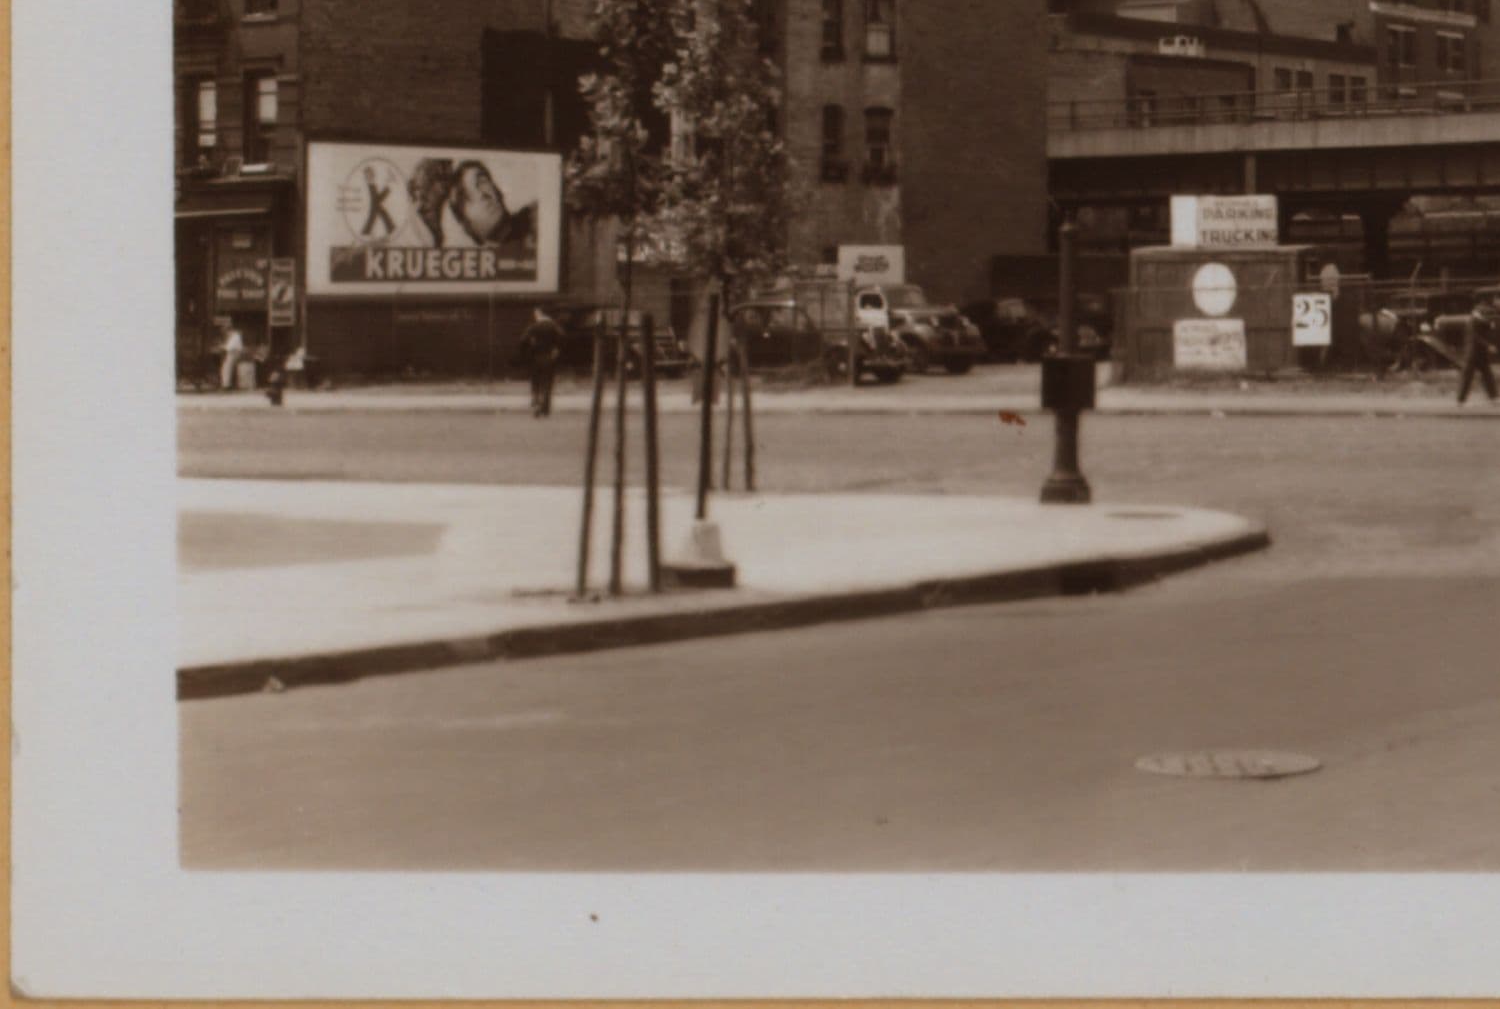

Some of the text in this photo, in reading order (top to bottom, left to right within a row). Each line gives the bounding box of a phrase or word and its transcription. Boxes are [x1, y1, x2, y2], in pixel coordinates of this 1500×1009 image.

[1202, 207, 1274, 221] PARKING
[364, 249, 497, 280] KRUEGER
[1295, 299, 1330, 329] 25
